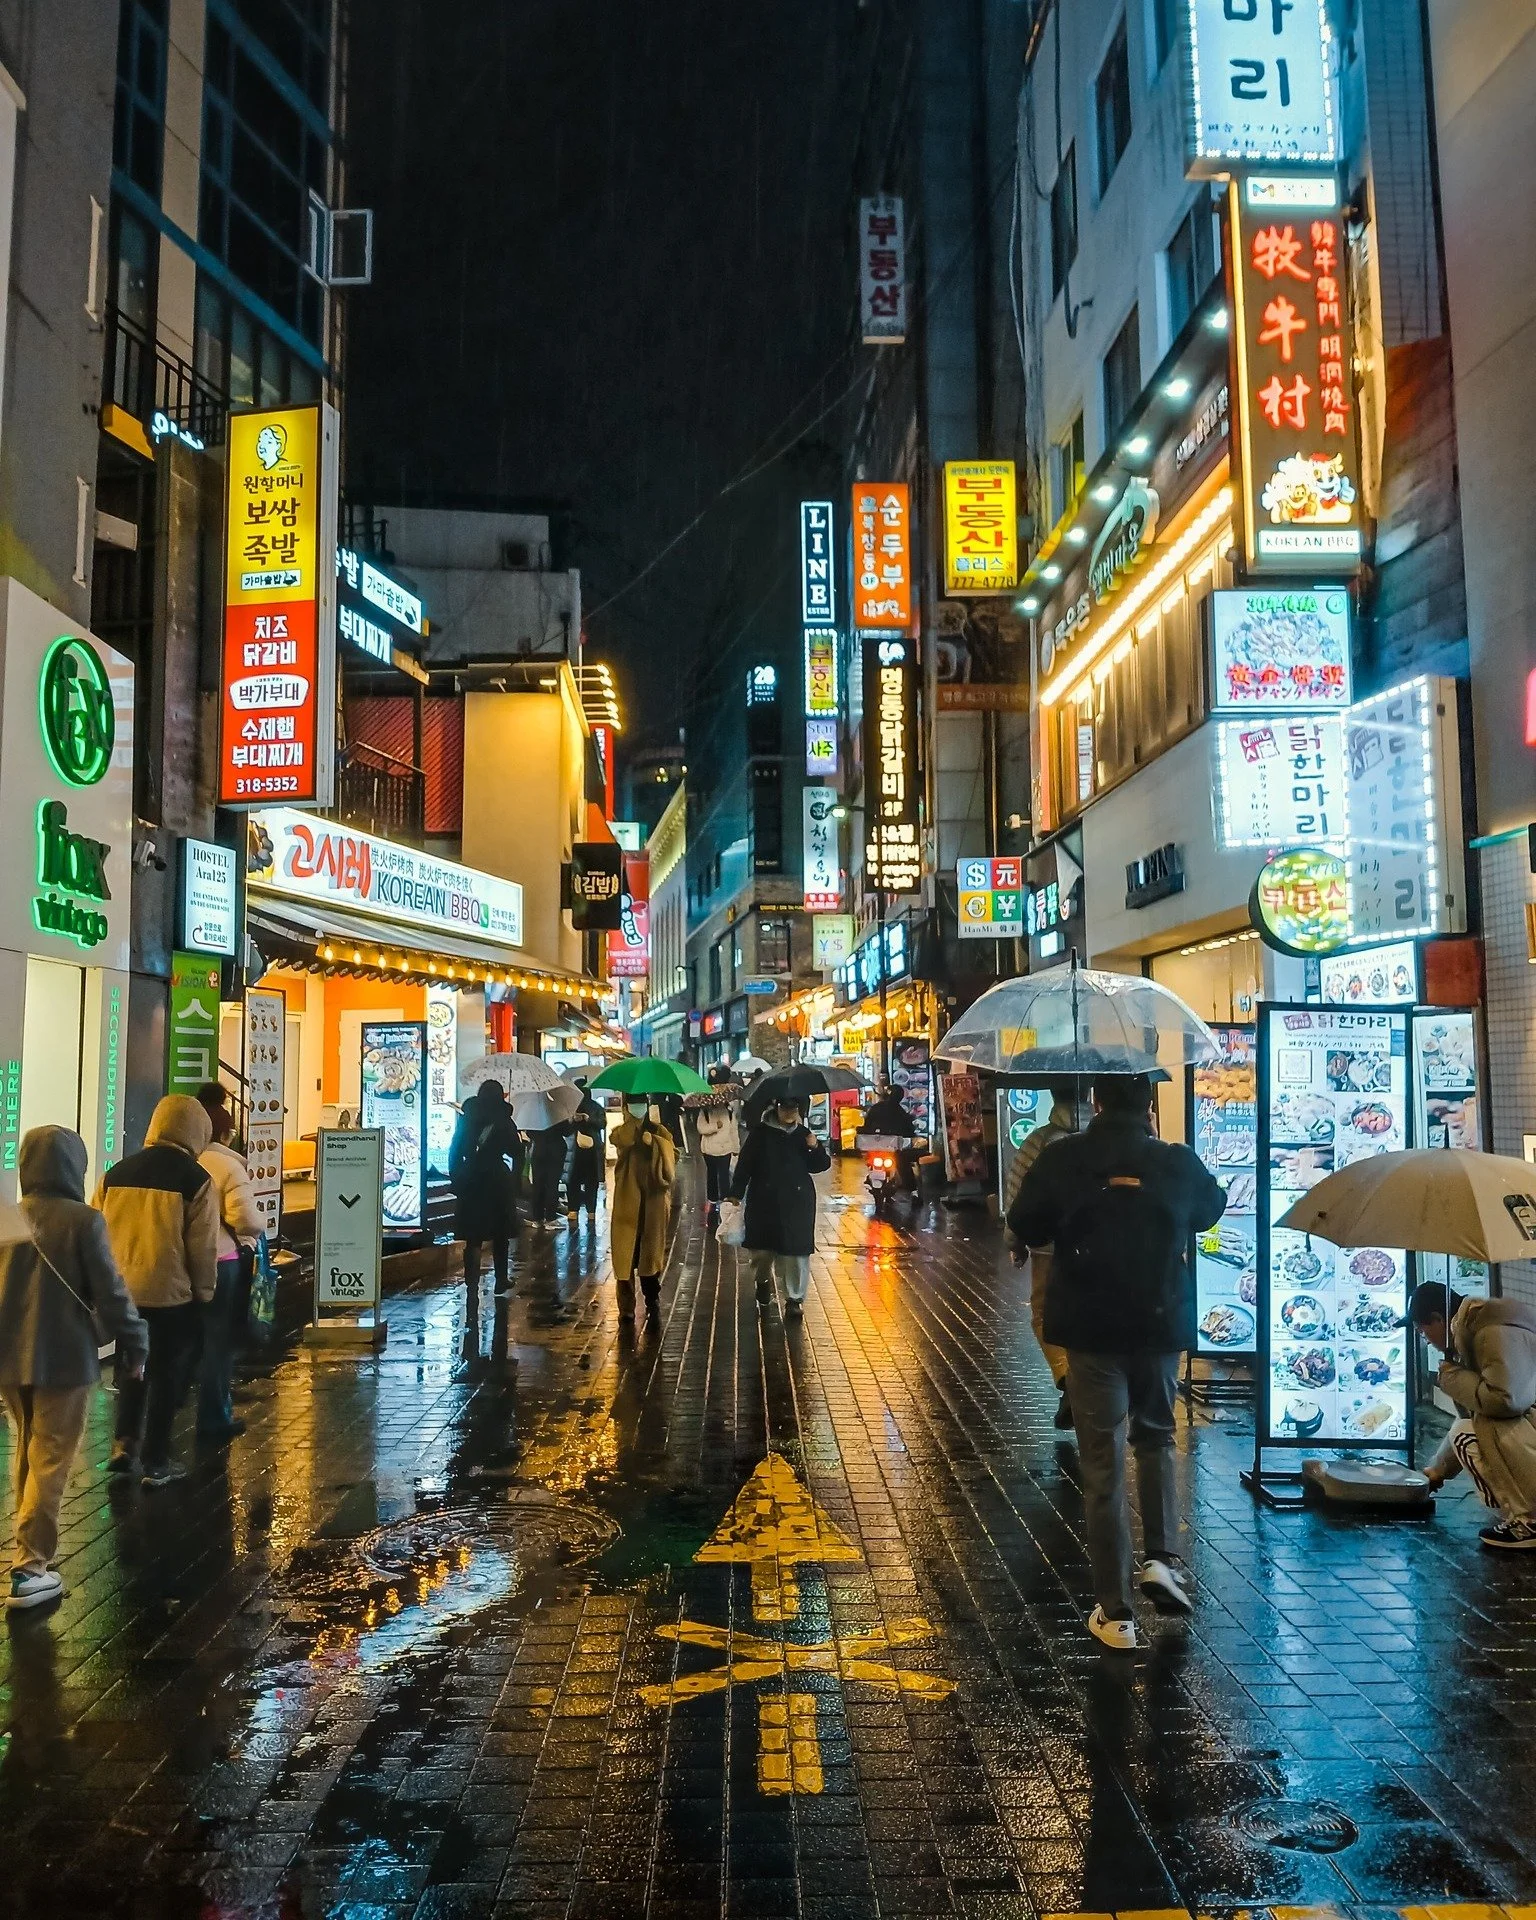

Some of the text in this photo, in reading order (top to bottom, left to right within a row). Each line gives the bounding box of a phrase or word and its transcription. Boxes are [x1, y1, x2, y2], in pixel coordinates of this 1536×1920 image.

[868, 215, 899, 316] 부동산
[1253, 225, 1311, 428] 牧牛村
[243, 473, 304, 494] 원할머니
[244, 497, 301, 527] 보쌈
[956, 478, 1008, 554] 부동산
[243, 532, 300, 566] 족발
[807, 508, 828, 604] LINE
[880, 495, 904, 590] 순두부
[255, 615, 288, 639] 치즈
[243, 641, 297, 667] 닭갈비
[812, 648, 830, 698] 부동산
[239, 683, 299, 703] 박가부대
[241, 716, 295, 741] 수제햄
[879, 667, 906, 801] 명동닭갈비
[232, 742, 304, 768] 부대찌개
[808, 740, 834, 757] 사주
[236, 776, 298, 793] 318-5352
[1288, 724, 1330, 836] 닭한마리
[193, 847, 230, 868] HOSTEL
[582, 876, 611, 894] 김밥
[996, 864, 1018, 887] 元
[376, 871, 480, 924] KOREAN BBQ
[964, 925, 993, 933] HanMi
[104, 986, 120, 1153] SECONDHAND
[3, 1060, 20, 1171] IN HERE
[1197, 1098, 1224, 1170] 牧牛村
[330, 1267, 364, 1287] fox
[330, 1288, 365, 1298] vintage
